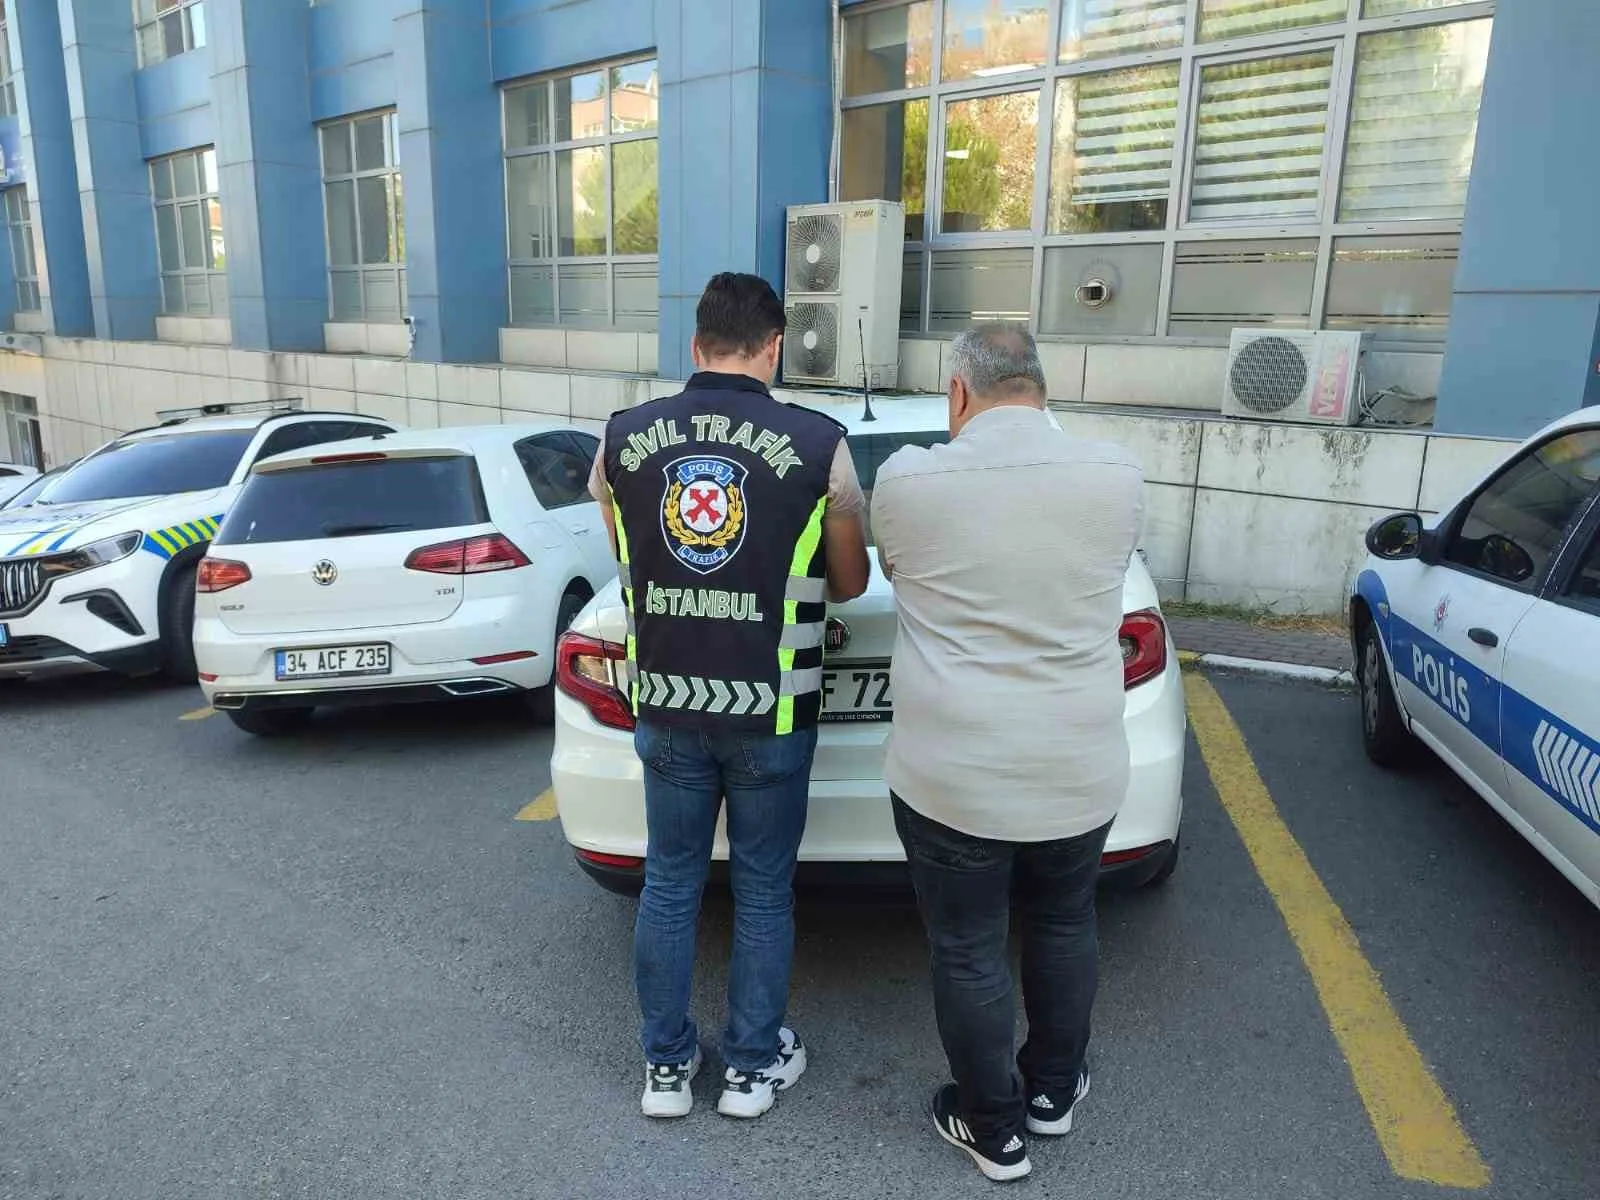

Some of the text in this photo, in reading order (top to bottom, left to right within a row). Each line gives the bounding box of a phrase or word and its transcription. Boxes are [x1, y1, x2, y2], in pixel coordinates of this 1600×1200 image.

[620, 415, 803, 479] SİVİL TRAFİK
[688, 462, 724, 474] POLİS
[646, 581, 763, 622] İSTANBUL
[287, 647, 386, 673] 34 ACF 235
[852, 672, 892, 708] 72
[1412, 643, 1470, 722] POLİS
